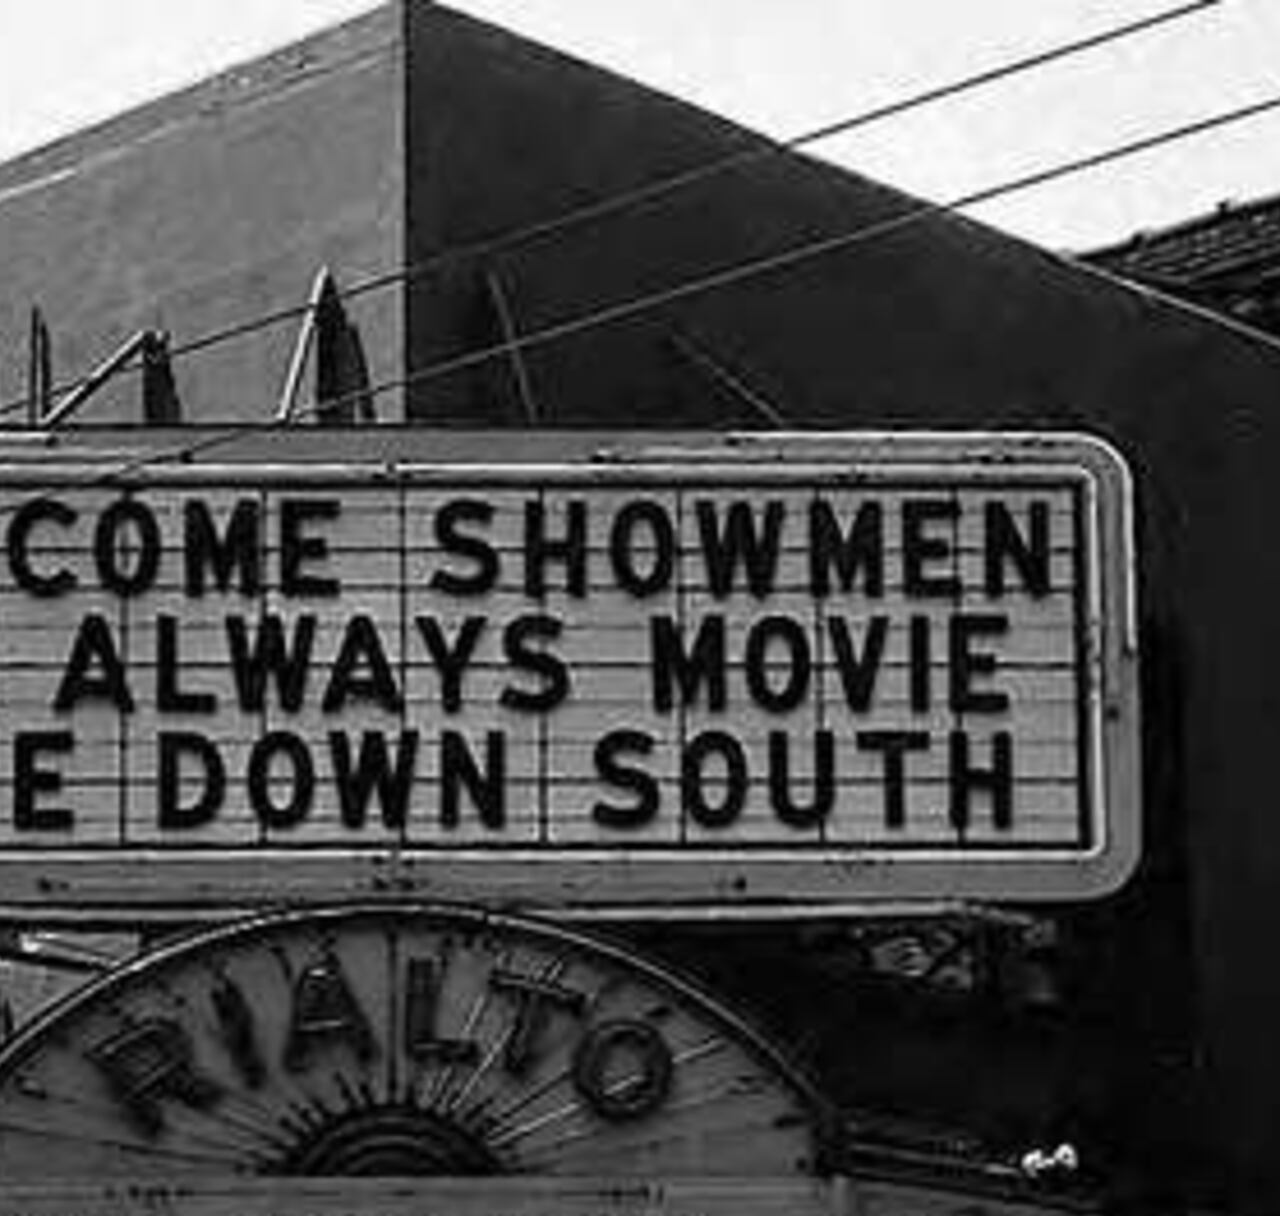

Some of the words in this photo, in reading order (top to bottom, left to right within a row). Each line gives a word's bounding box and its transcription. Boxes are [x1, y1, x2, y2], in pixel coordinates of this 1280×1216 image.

[428, 500, 1051, 600] SHOWMEN
[53, 614, 572, 716] ALWAYS
[650, 615, 1010, 716] MOVIE
[157, 731, 507, 833] DOWN
[592, 731, 1014, 833] SOUTH
[84, 953, 674, 1138] RIALTO
